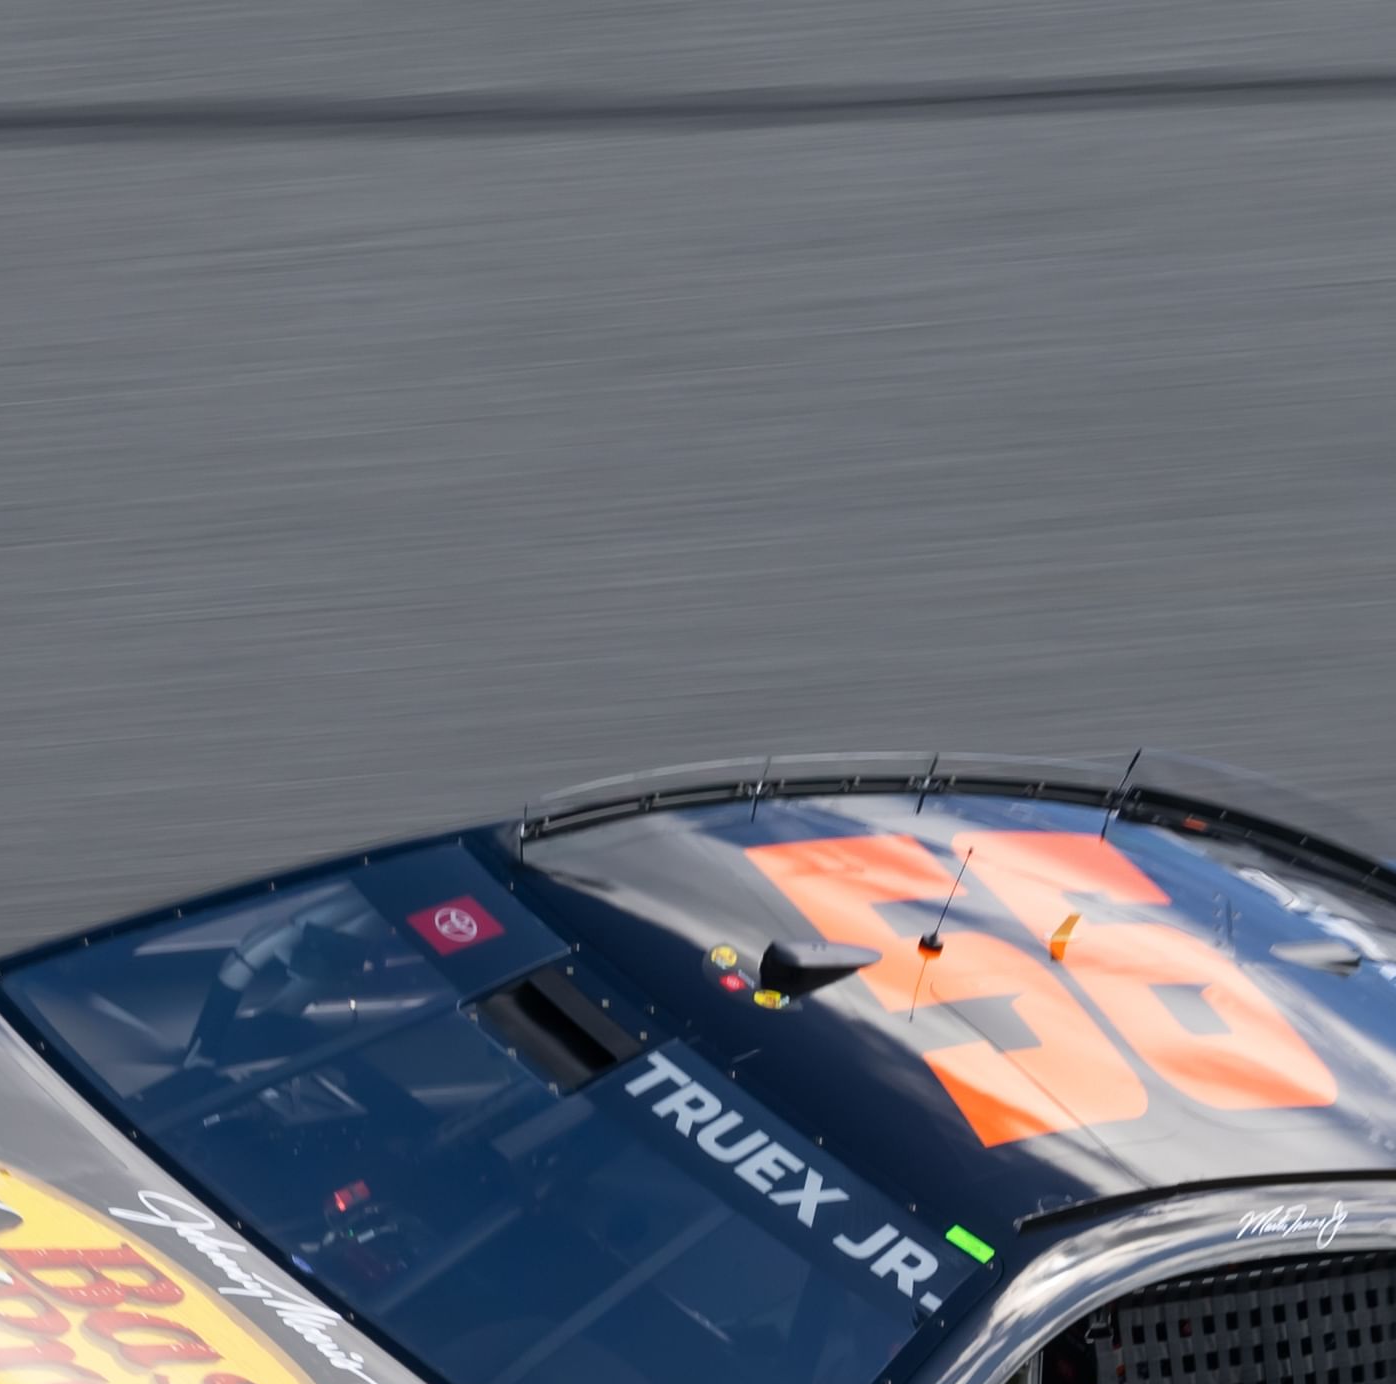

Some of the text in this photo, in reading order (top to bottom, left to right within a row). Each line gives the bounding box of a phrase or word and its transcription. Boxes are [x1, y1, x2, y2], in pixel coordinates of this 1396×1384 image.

[745, 831, 1338, 1148] 56
[624, 1050, 943, 1313] TRUEX JR.
